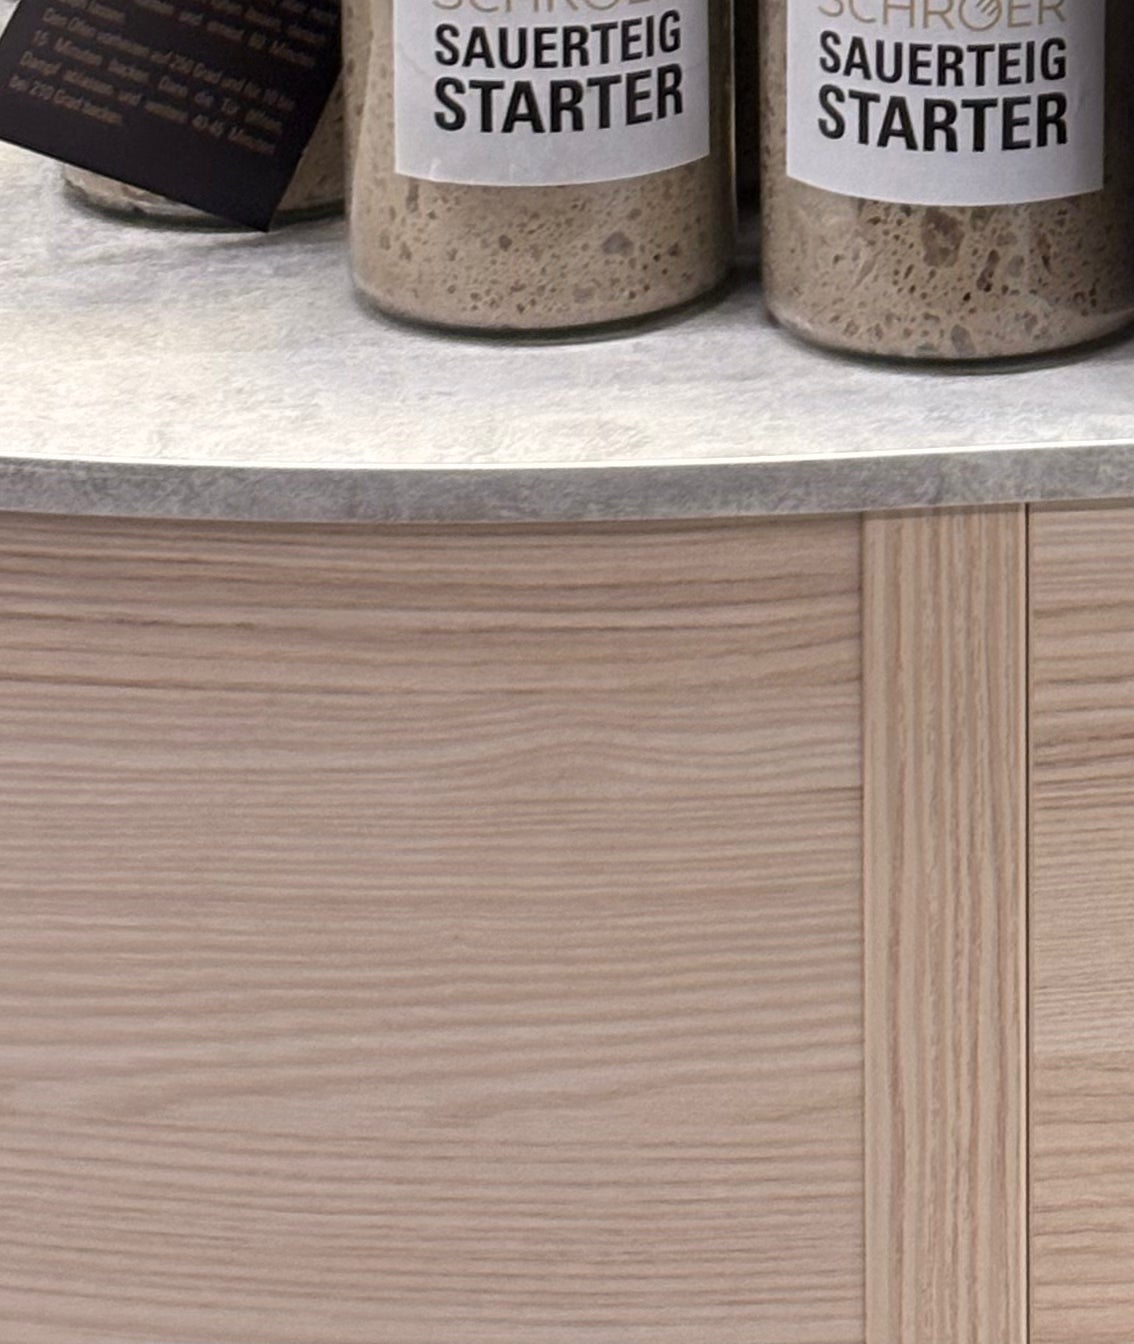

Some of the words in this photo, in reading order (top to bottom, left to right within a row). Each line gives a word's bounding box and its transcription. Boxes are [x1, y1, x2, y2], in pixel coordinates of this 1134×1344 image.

[434, 9, 681, 70] SAUERTEIG
[818, 30, 1067, 88] SAUERTEIG
[434, 62, 684, 134] STARTER
[817, 83, 1068, 153] STARTER
